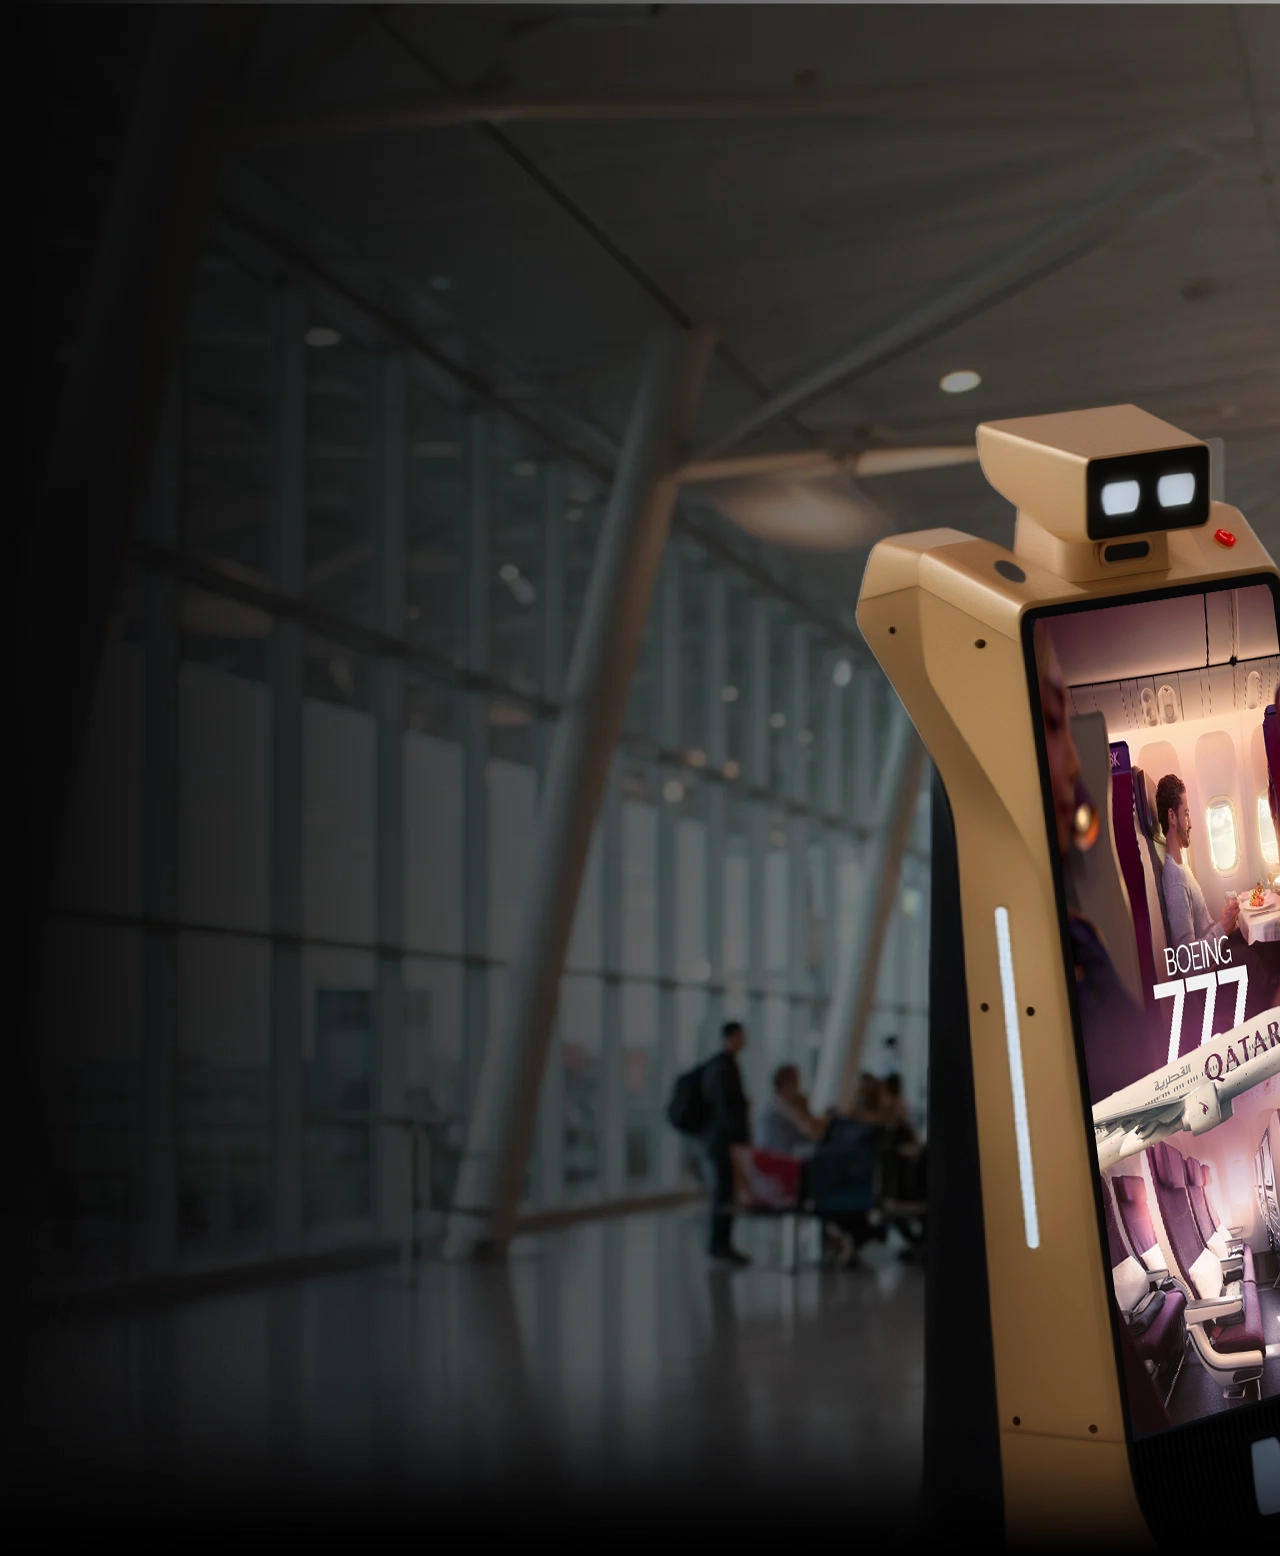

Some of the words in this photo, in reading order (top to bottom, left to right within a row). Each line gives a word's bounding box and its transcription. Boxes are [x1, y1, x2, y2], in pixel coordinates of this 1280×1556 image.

[1164, 935, 1232, 976] BOEING
[1153, 965, 1249, 1065] 777
[1154, 1063, 1191, 1091] القطرية
